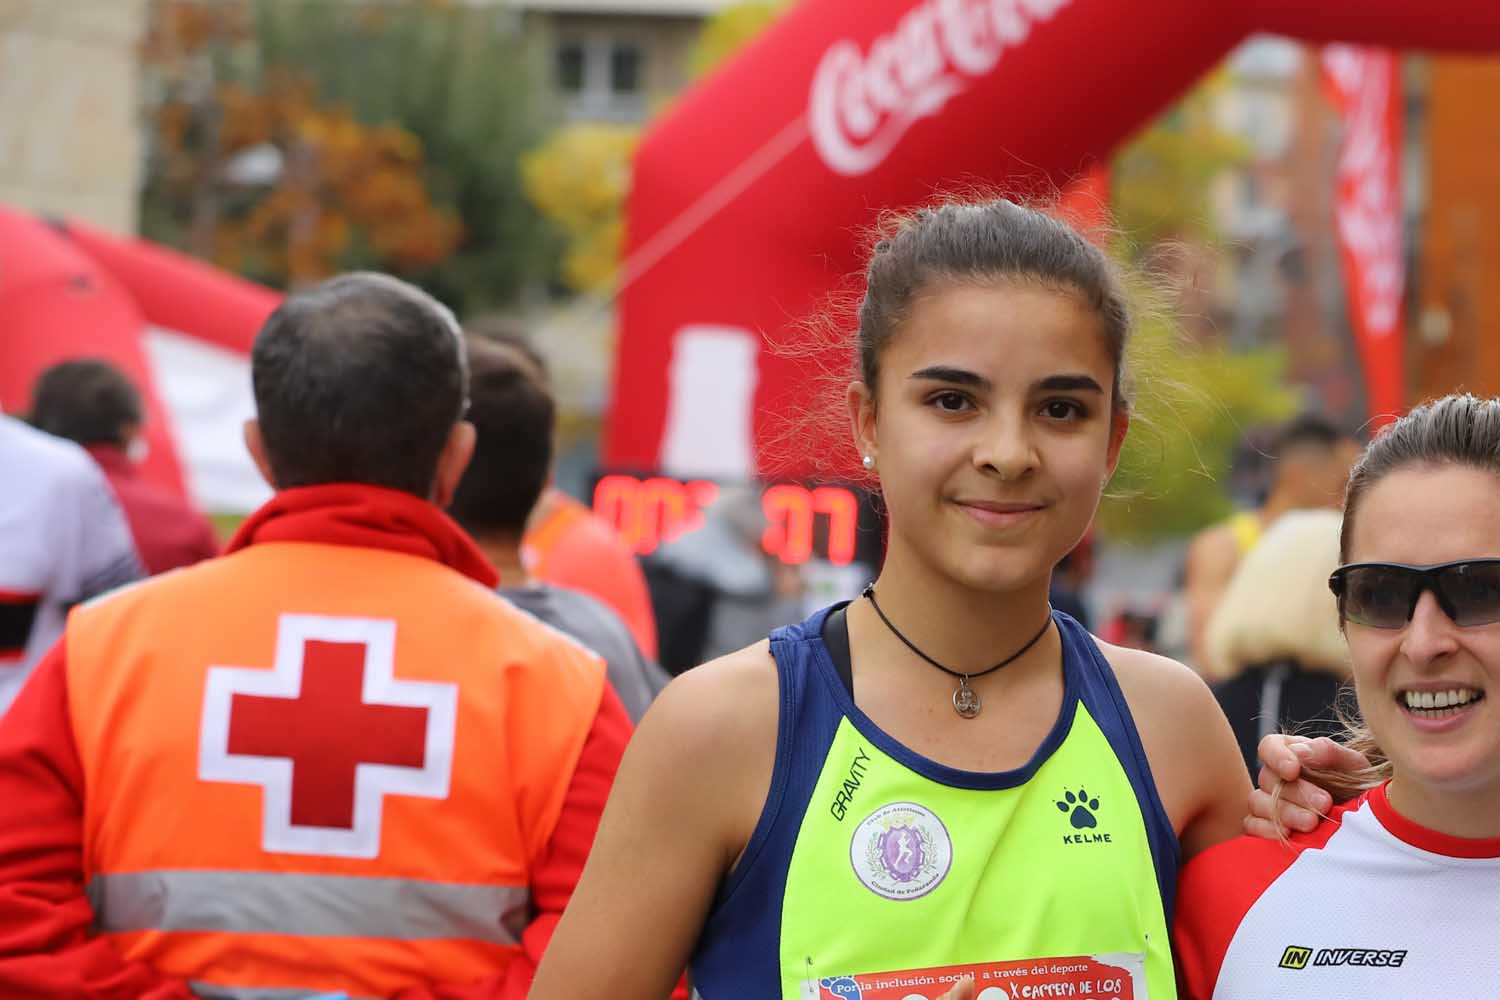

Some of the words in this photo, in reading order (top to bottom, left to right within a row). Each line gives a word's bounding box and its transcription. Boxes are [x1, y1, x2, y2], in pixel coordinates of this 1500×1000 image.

[830, 746, 871, 822] GRAVITY
[1063, 833, 1112, 845] KELME
[1314, 948, 1407, 967] INVERSE
[837, 984, 857, 994] Por
[860, 981, 872, 990] la
[876, 975, 935, 989] inclusión
[994, 967, 1028, 978] través
[1031, 965, 1048, 975] del
[1050, 963, 1088, 975] deporte
[1010, 981, 1019, 999] X
[1079, 980, 1092, 994] DE
[1097, 978, 1122, 994] LOS
